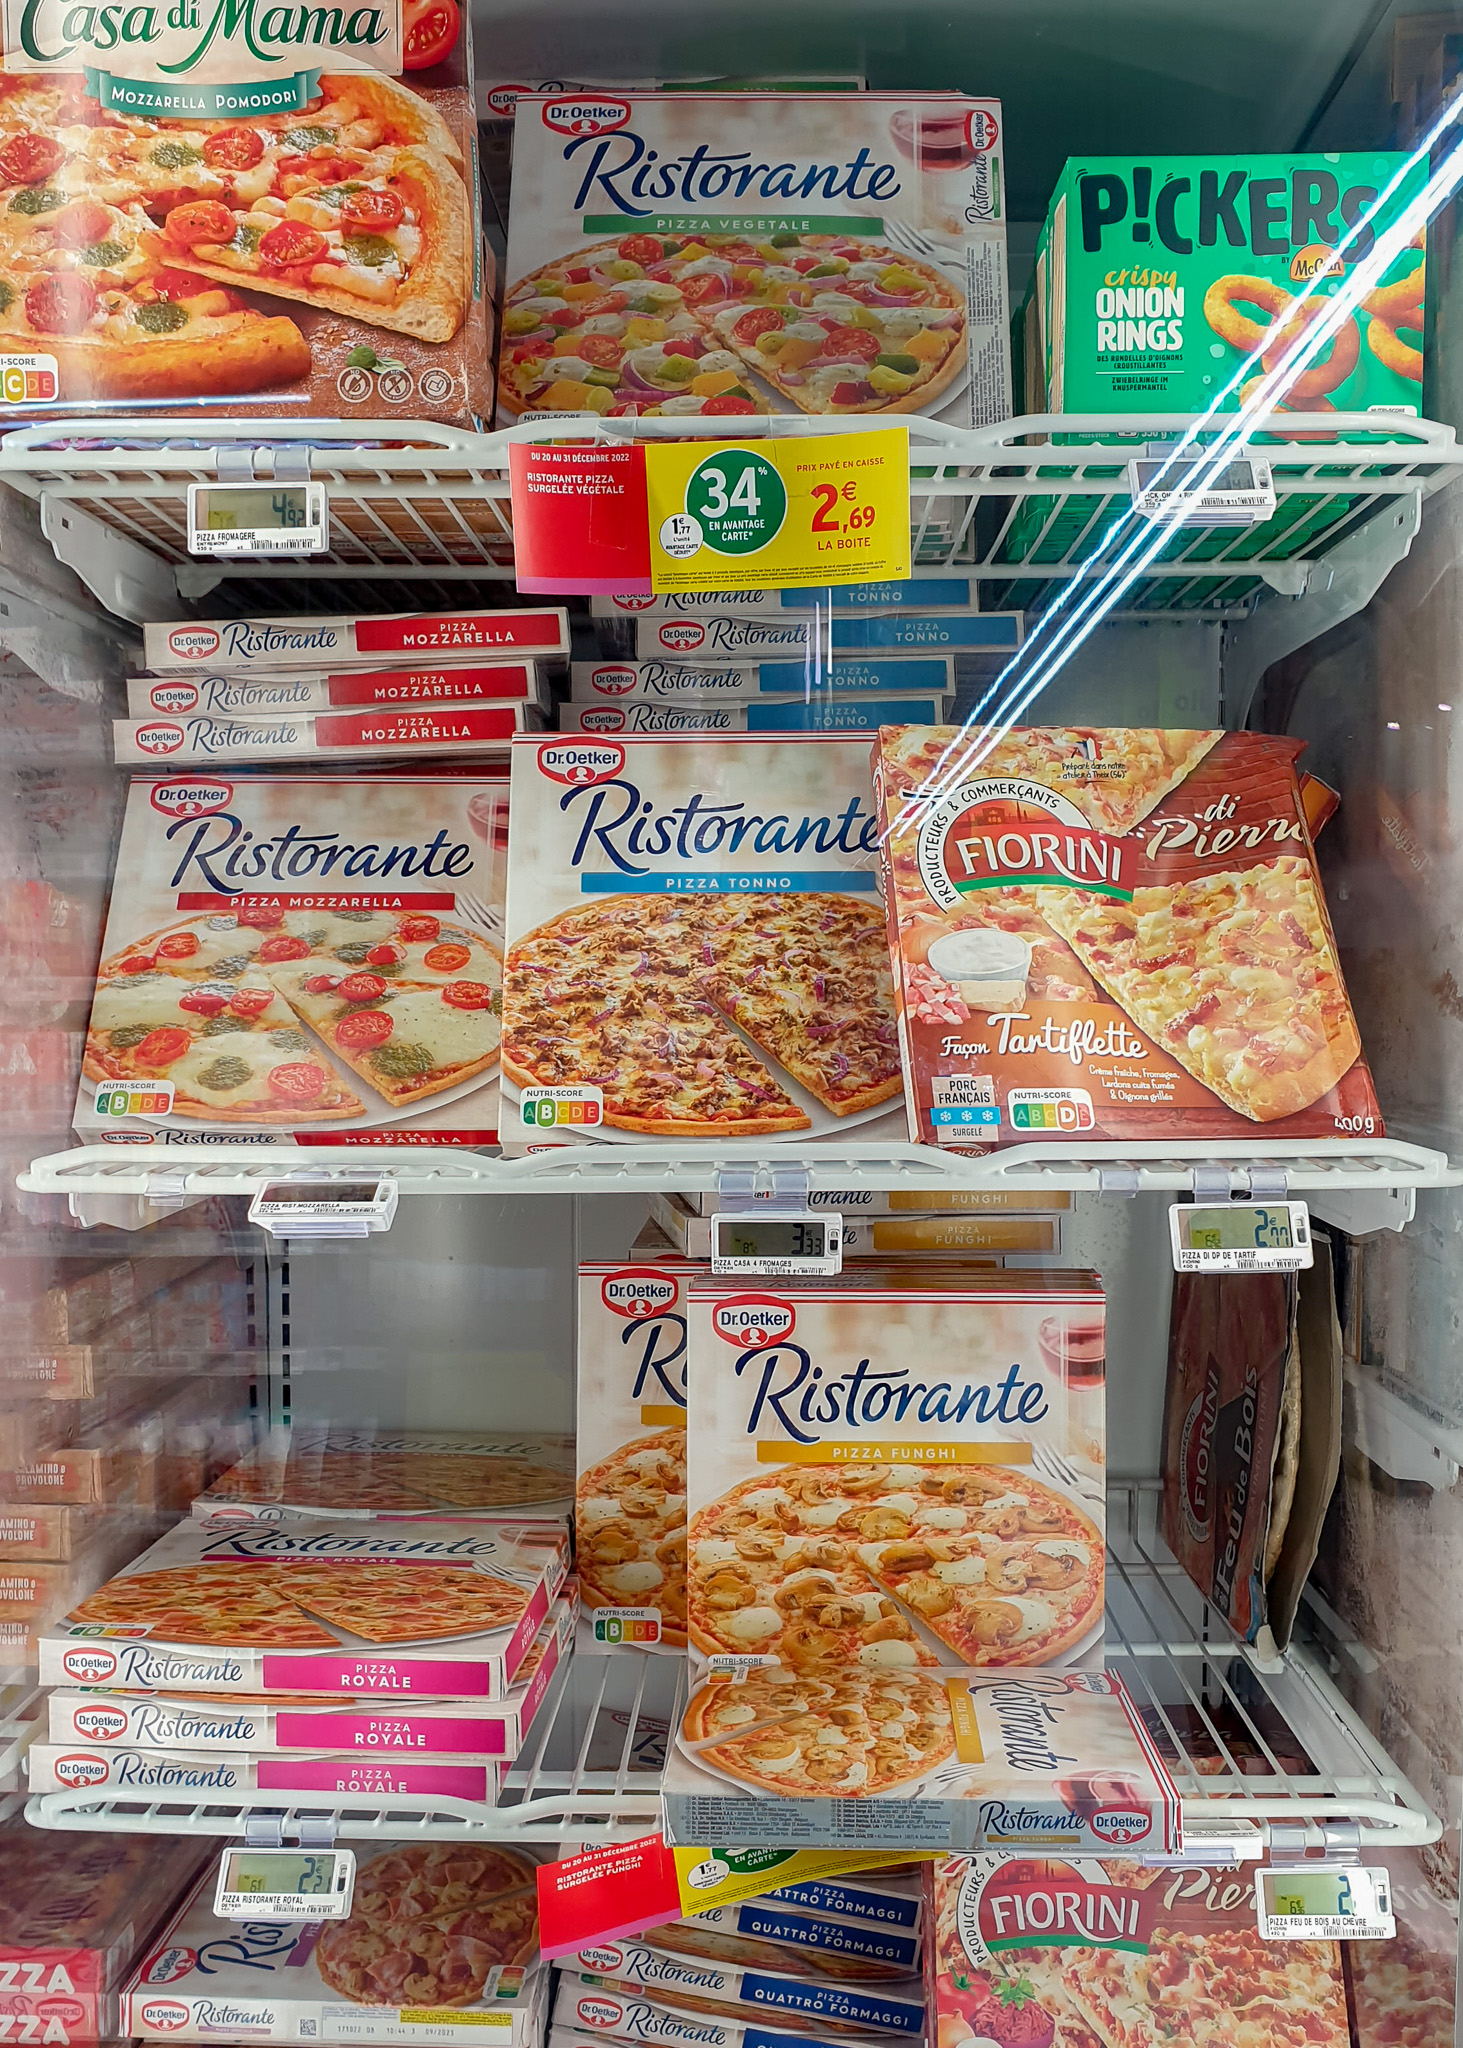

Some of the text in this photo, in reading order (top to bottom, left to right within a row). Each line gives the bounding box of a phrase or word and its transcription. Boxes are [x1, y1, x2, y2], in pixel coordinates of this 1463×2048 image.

[20, 0, 388, 74] Casa di Mama
[111, 88, 298, 110] MOZZARELLA POMODORI
[563, 131, 901, 216] Ristorante
[657, 218, 811, 232] PIZZA VEGETALE
[1104, 265, 1177, 292] crispy
[1095, 286, 1184, 319] ONION
[1097, 319, 1184, 352] RINGS
[1097, 354, 1108, 362] DES
[1110, 354, 1147, 362] RONDELLES
[531, 452, 630, 463] DU 20 AU 31 DÉCEMBRE 2022
[796, 457, 885, 472] PRIX PAYÉ EN CAISSE
[527, 472, 615, 484] RISTORANTE PIZZA
[527, 483, 625, 495] SURGELÉE VÉGÉTALE
[708, 519, 765, 531] EN AVANTAGE
[196, 532, 256, 541] PIZZA FROMAGERE
[817, 537, 871, 551] LA BOITE
[848, 592, 903, 602] TONNO
[439, 622, 477, 632] PIZZA
[708, 616, 812, 650] Ristorante
[222, 622, 338, 657] Ristorante
[402, 631, 516, 646] MOZZARELLA
[895, 631, 951, 641] TONNO
[639, 662, 744, 695] Ristorante
[826, 675, 880, 686] TONNO
[200, 677, 312, 711] Ristorante
[374, 683, 484, 699] MOZZARELLA
[628, 703, 732, 731] Ristorante
[814, 716, 868, 727] TONNO
[186, 717, 298, 754] Ristorante
[361, 725, 471, 741] MOZZARELLA
[1203, 793, 1242, 822] di
[925, 782, 1061, 905] PRODUCTEURS & COMMERÇANTS
[166, 812, 475, 895] Ristorante
[955, 832, 1123, 885] FIORINI
[666, 877, 792, 889] PIZZA TONNO
[230, 896, 403, 907] PIZZA MOZZARELLA
[939, 1012, 1149, 1065] Façon Tartiflette
[1089, 1064, 1113, 1076] Crème
[102, 1082, 156, 1090] NUTRI-SCORE
[949, 1080, 977, 1091] PORC
[1101, 1077, 1175, 1090] Lardons cuits fumés
[526, 1089, 583, 1098] NUTRI-SCORE
[938, 1091, 991, 1105] FRANÇAIS
[1014, 1091, 1072, 1099] NUTRI-SCORE
[1110, 1089, 1174, 1103] & Oignons grillés
[952, 1126, 983, 1136] SURGELÉ
[346, 1136, 462, 1144] MOZZARELLA
[951, 1194, 1009, 1204] FUNGHI
[948, 1226, 980, 1235] PIZZA
[935, 1235, 992, 1244] FUNGHI
[735, 1342, 1049, 1443] Ristorante
[1194, 1370, 1219, 1507] FIORINI
[832, 1447, 957, 1459] PIZZA FUNGHI
[16, 1474, 64, 1485] PROVOLONE
[1214, 1362, 1258, 1592] Feu de Bois
[356, 1664, 396, 1674] PIZZA
[341, 1675, 412, 1688] ROYALE
[370, 1722, 411, 1732] PIZZA
[354, 1733, 426, 1747] ROYALE
[351, 1769, 392, 1779] PIZZA
[336, 1780, 407, 1793] ROYALE
[561, 1862, 572, 1870] DU
[572, 1858, 582, 1866] 20
[583, 1855, 593, 1864] AU
[594, 1853, 602, 1861] 31
[603, 1843, 639, 1857] DÉCEMBRE
[639, 1838, 657, 1848] 2022
[734, 1855, 746, 1863] EN
[556, 1854, 644, 1885] RISTORANTE PIZZA
[557, 1861, 642, 1891] SURGELÉE FUNGHI
[221, 1895, 304, 1904] PIZZA RISTORANTE ROYAL
[825, 1897, 903, 1922] FORMAGGI
[963, 1869, 988, 1964] PRODUCTEURS
[990, 1891, 1140, 1943] FIORINI
[1269, 1918, 1287, 1926] PIZZA
[1304, 1918, 1312, 1926] DE
[1314, 1918, 1330, 1926] BOIS
[1332, 1918, 1341, 1926] AU
[1342, 1917, 1367, 1926] CHEVRE
[751, 1921, 901, 1959] QUATTRO FORMAGGI
[754, 1988, 909, 2027] QUATTRO FORMAGGI
[387, 2027, 406, 2035] 10:44
